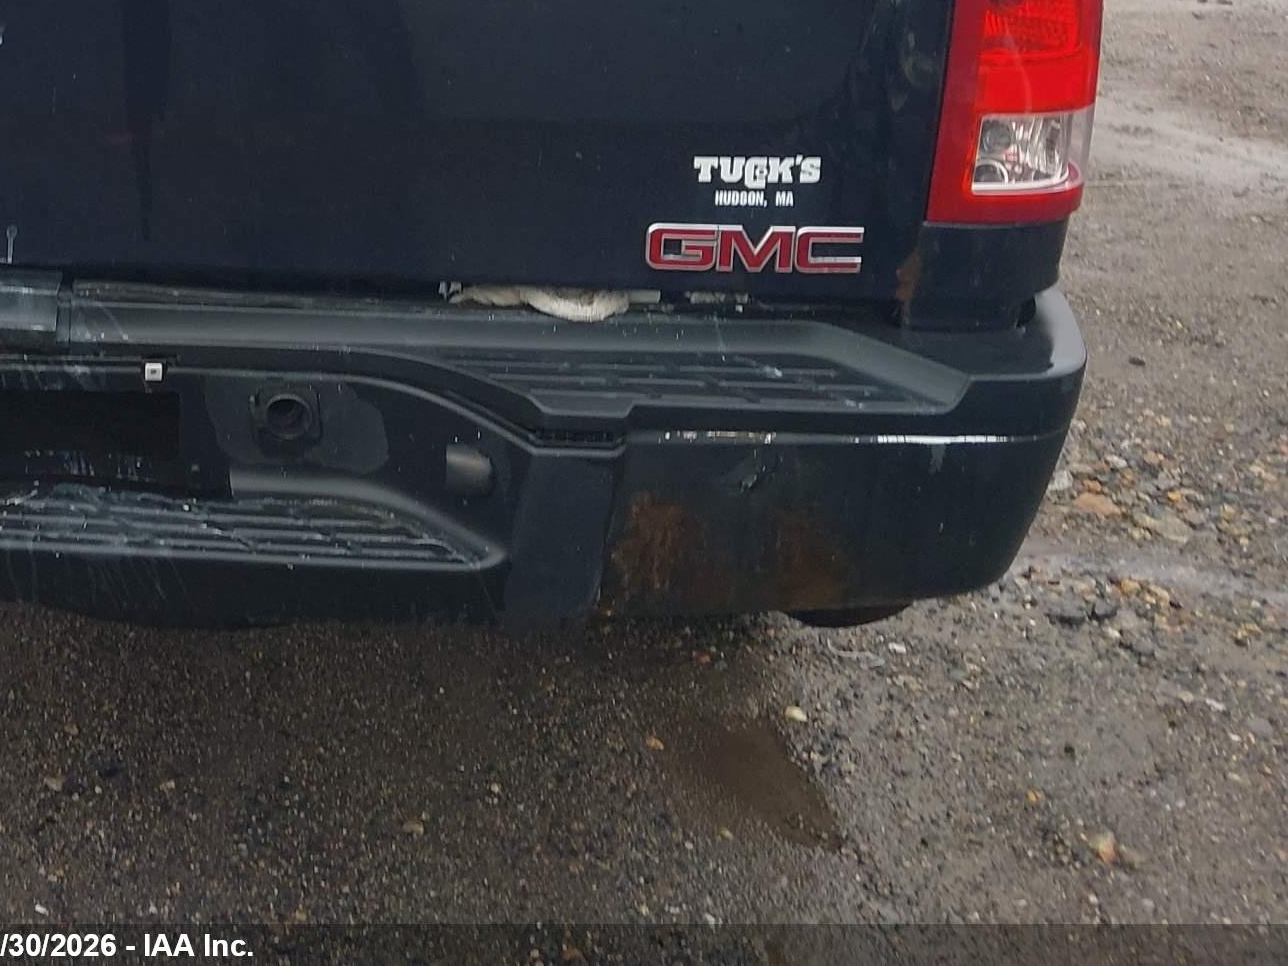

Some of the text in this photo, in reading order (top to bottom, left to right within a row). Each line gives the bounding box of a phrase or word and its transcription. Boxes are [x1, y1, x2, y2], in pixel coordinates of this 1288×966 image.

[692, 154, 822, 189] TUCK'S
[774, 190, 795, 207] MA
[645, 222, 866, 274] GMC
